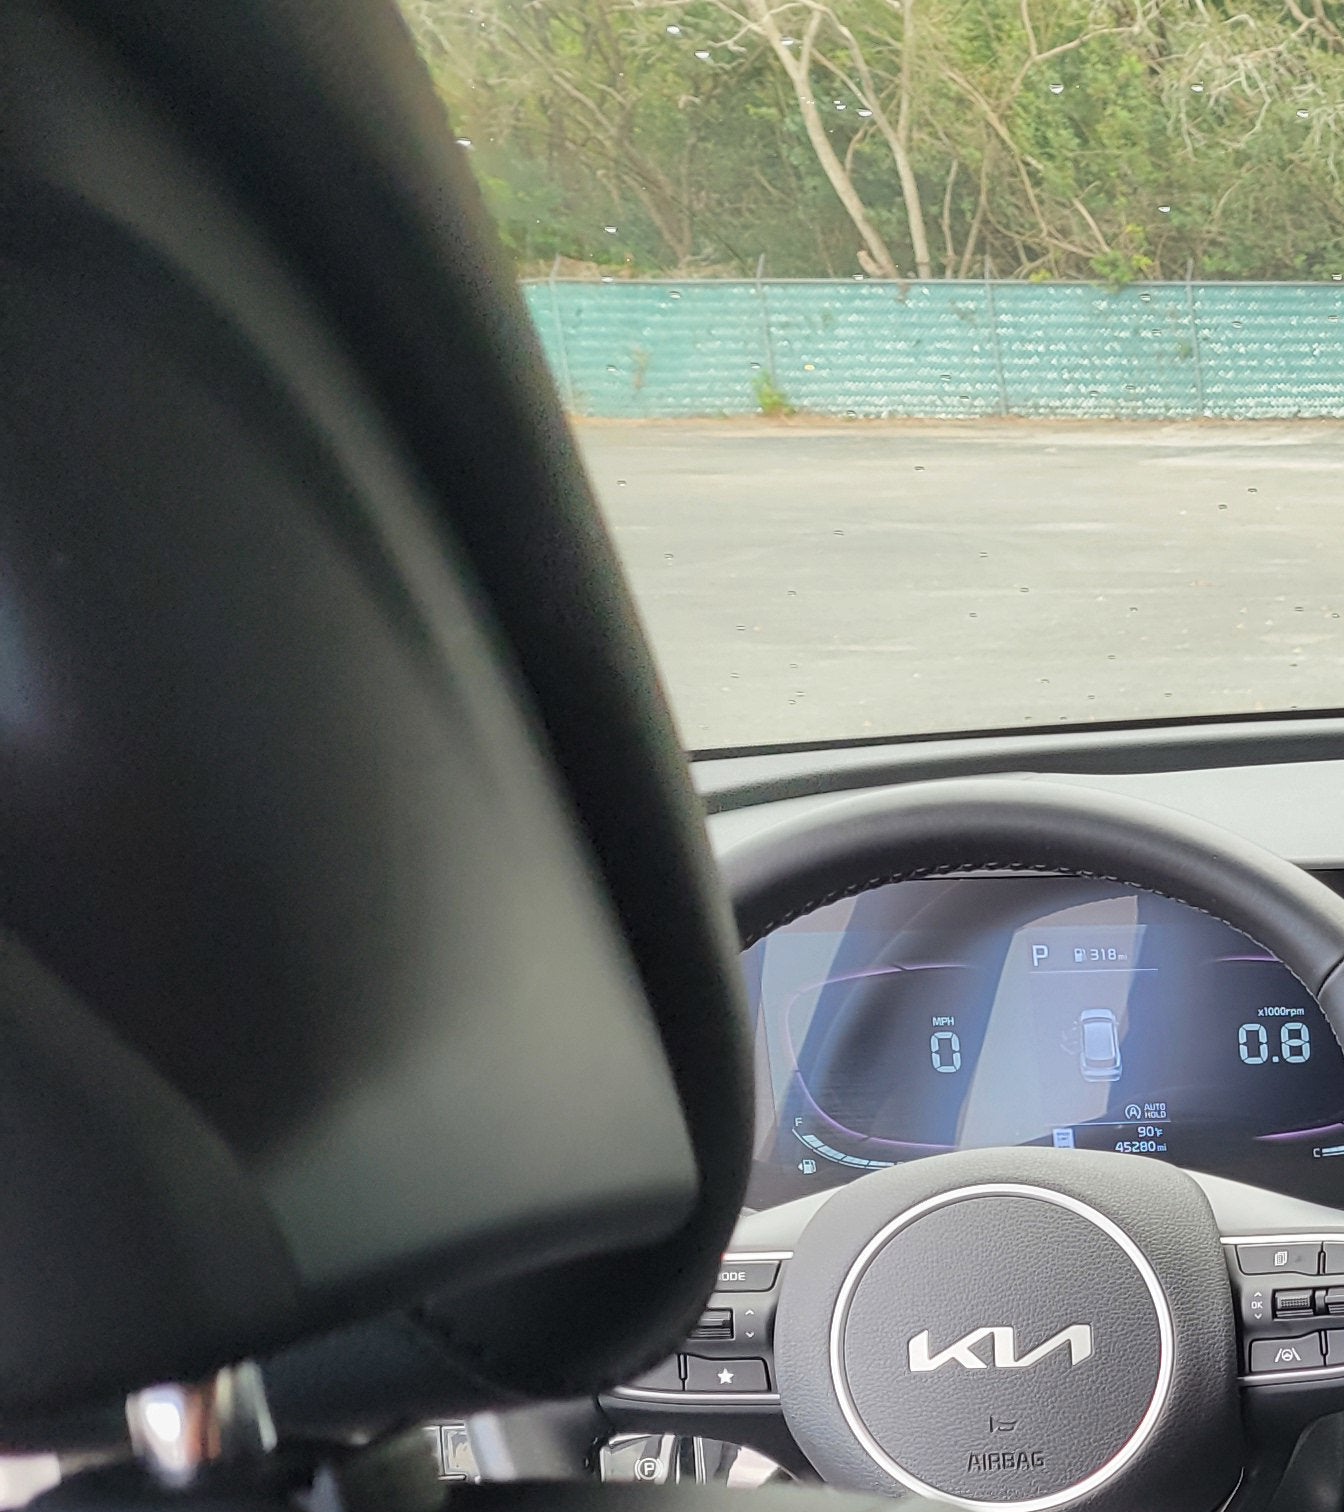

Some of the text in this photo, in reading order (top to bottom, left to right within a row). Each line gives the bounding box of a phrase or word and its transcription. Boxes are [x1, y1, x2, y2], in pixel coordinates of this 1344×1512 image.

[1031, 944, 1049, 966] P
[1089, 948, 1117, 961] 318
[1257, 1006, 1305, 1018] x1000rpm
[932, 1016, 955, 1026] MPH
[1237, 1021, 1311, 1066] 0.8
[930, 1031, 961, 1074] 0
[1143, 1102, 1166, 1112] AUTO
[1143, 1110, 1167, 1119] HOLD
[795, 1117, 804, 1127] F
[1115, 1140, 1157, 1153] 45280
[1313, 1148, 1321, 1158] C
[719, 1271, 747, 1282] ODE
[1250, 1300, 1264, 1310] OK
[966, 1450, 1047, 1473] AIRBAG
